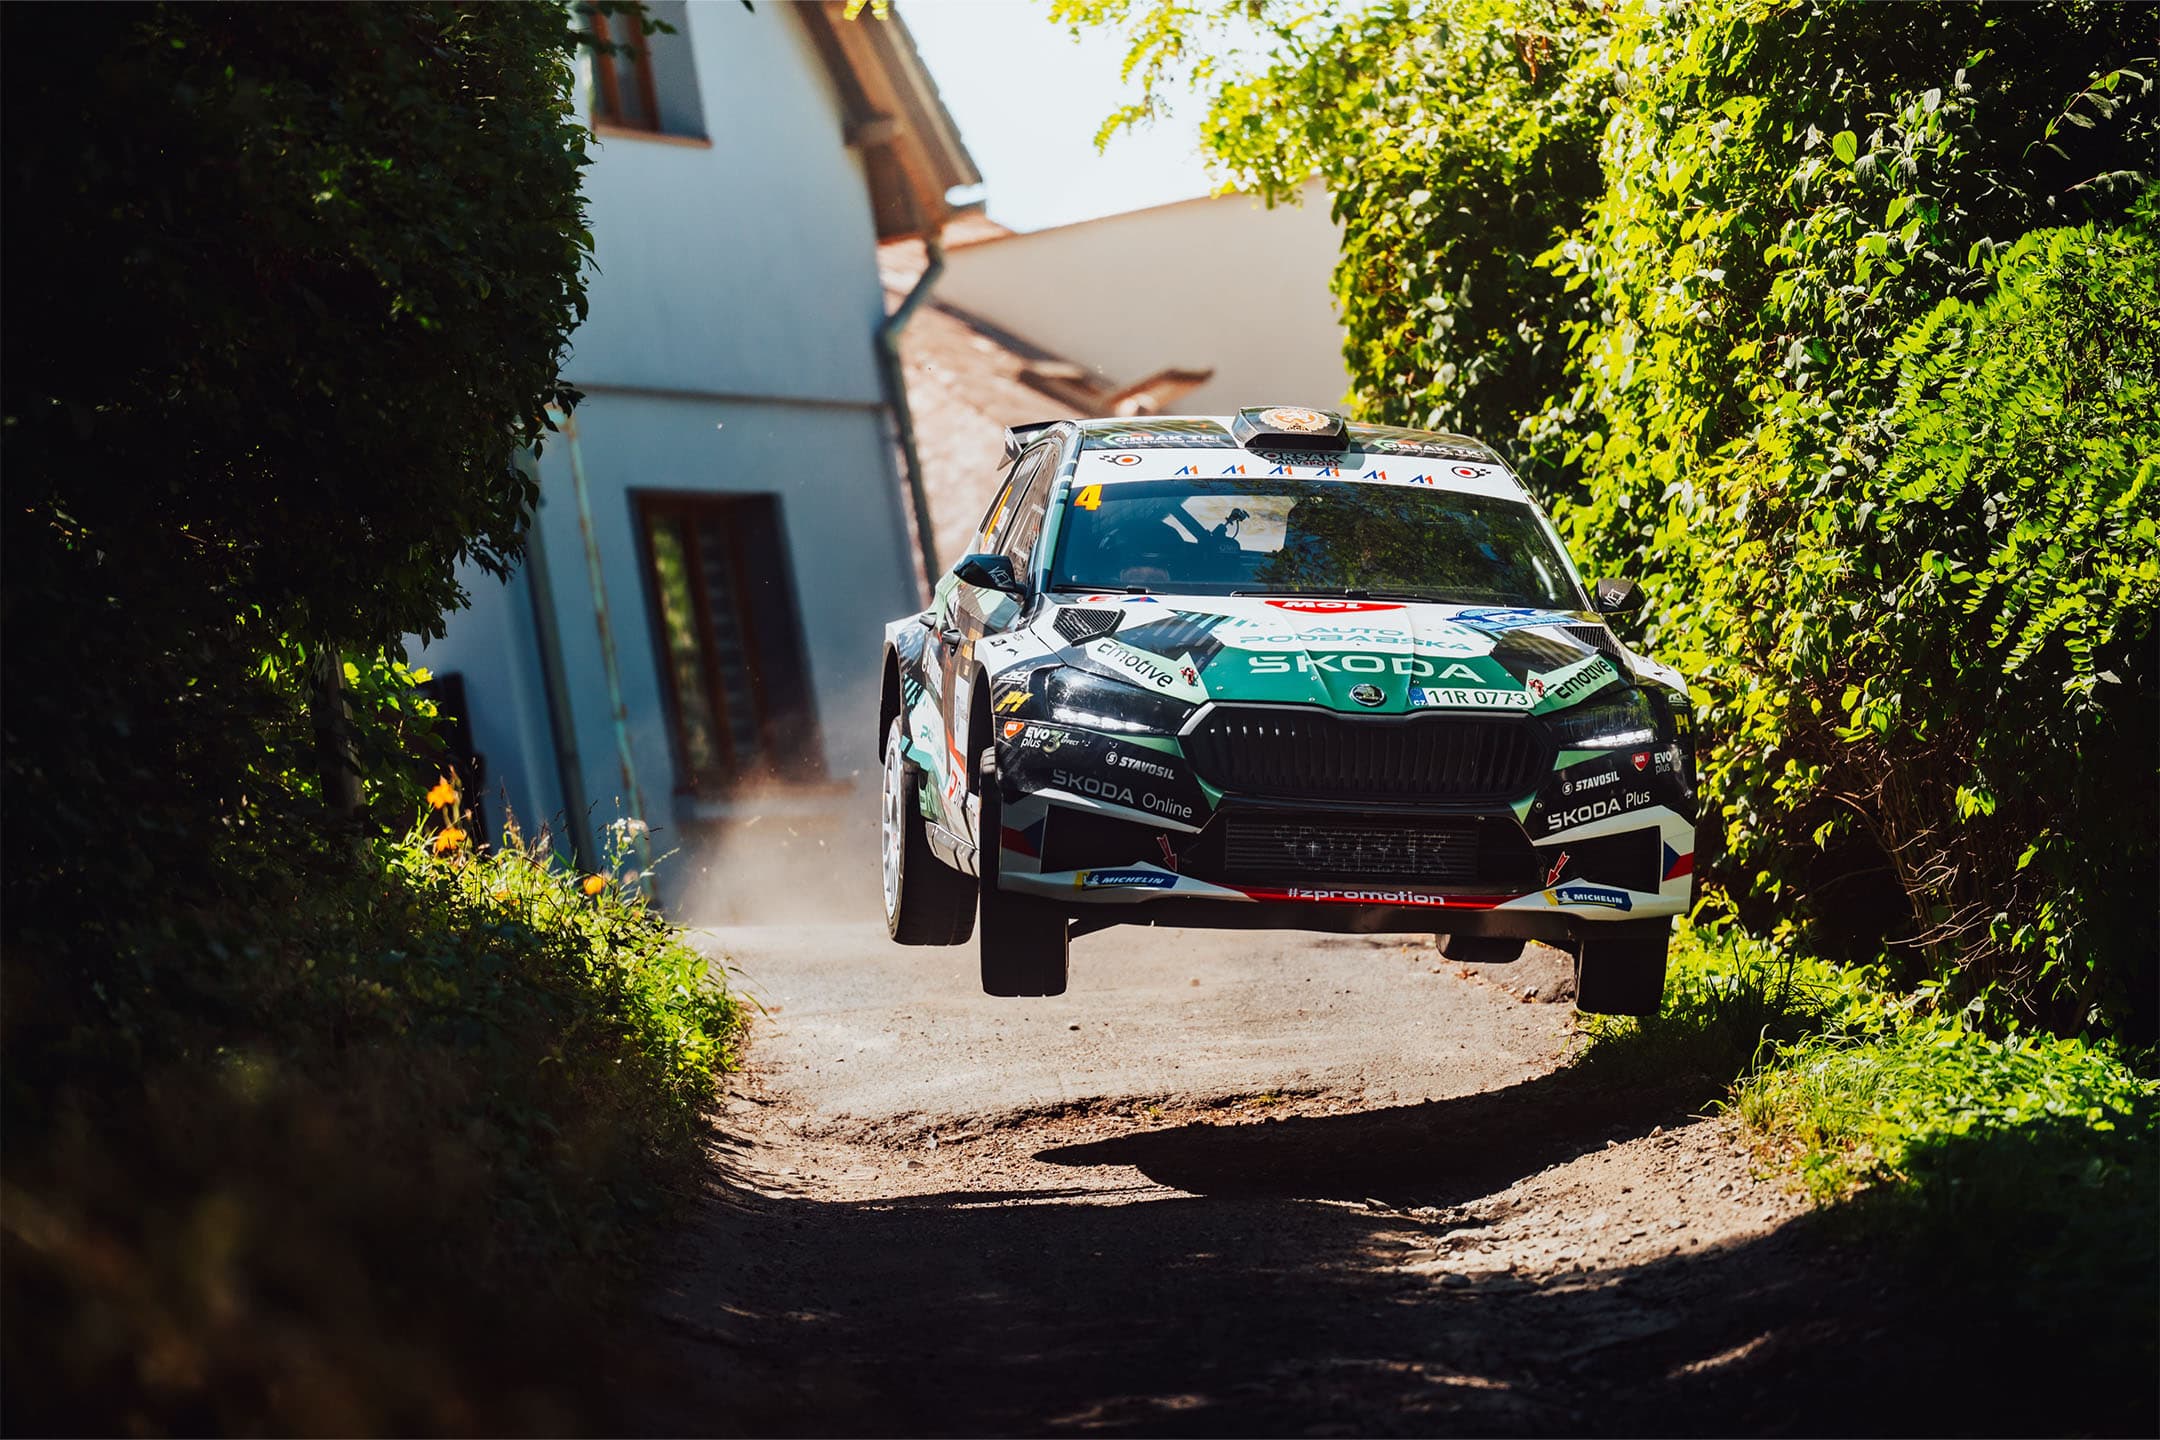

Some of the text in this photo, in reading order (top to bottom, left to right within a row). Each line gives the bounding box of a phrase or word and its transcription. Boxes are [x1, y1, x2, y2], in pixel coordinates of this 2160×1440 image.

[1074, 484, 1103, 511] 4
[1280, 601, 1361, 610] MOL
[1306, 627, 1405, 637] AUTO
[1428, 690, 1528, 706] 11R 0773
[1025, 726, 1050, 740] EVO
[1020, 737, 1041, 748] plus
[1654, 751, 1672, 764] EVO
[1118, 756, 1175, 780] STAVOSIL
[1656, 763, 1671, 775] plus
[1575, 771, 1621, 792] STAVOSIL
[1142, 792, 1193, 819] Online
[1625, 791, 1651, 809] Plus
[1101, 875, 1165, 885] MICHELIN
[1287, 887, 1446, 906] #zpromotion
[1573, 893, 1623, 904] MICHELIN
